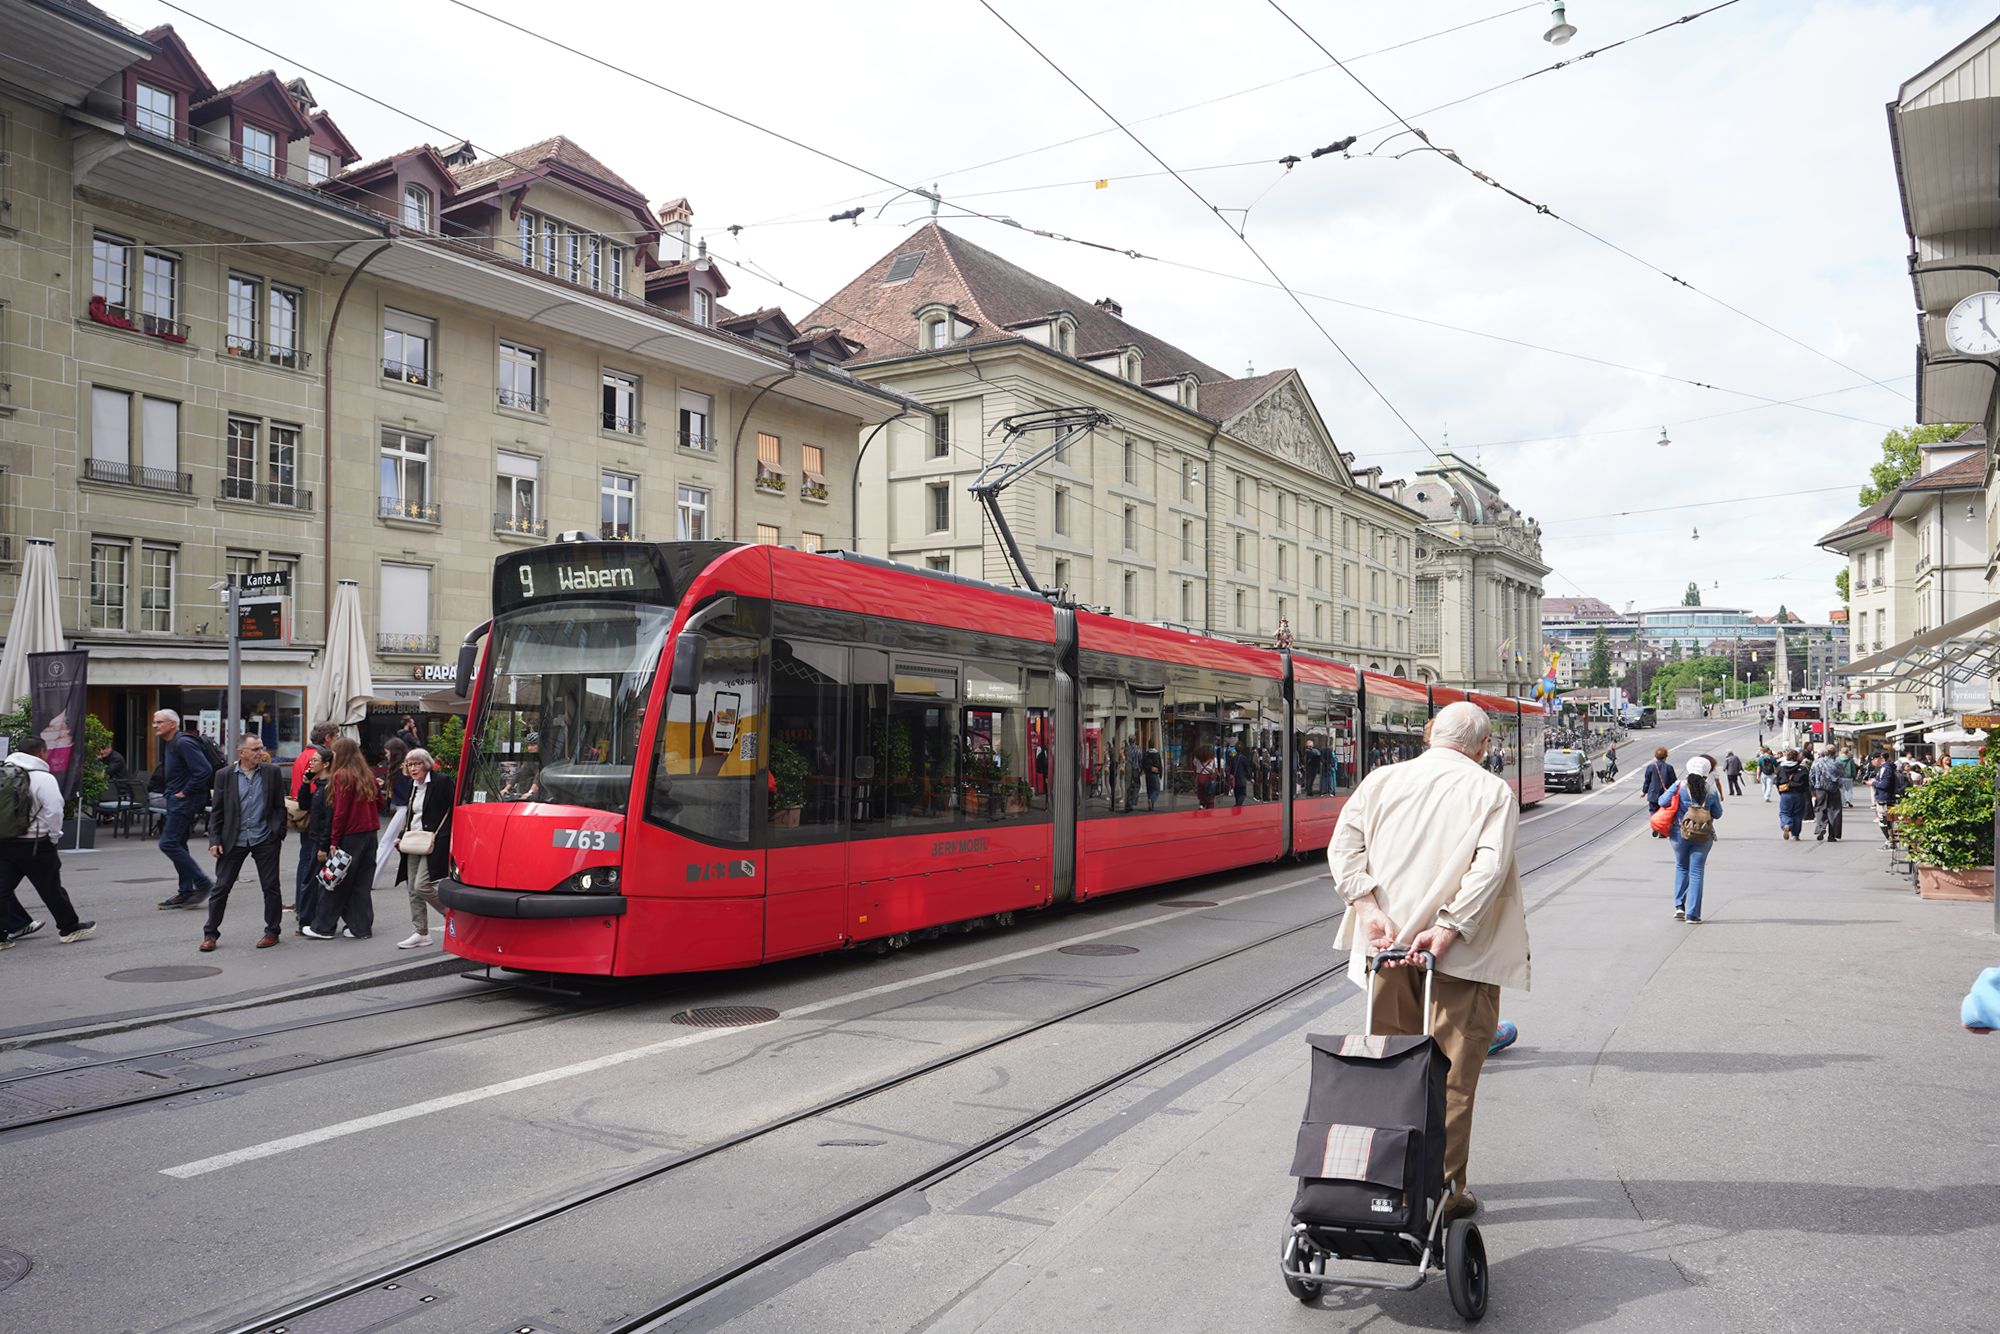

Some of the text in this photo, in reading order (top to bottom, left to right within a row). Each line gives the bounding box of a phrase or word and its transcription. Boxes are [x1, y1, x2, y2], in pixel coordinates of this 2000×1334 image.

[247, 573, 281, 586] Kante A
[519, 565, 634, 597] 9 Wabern
[425, 666, 457, 679] PAPA
[373, 704, 396, 714] PAPA
[565, 830, 605, 850] 763
